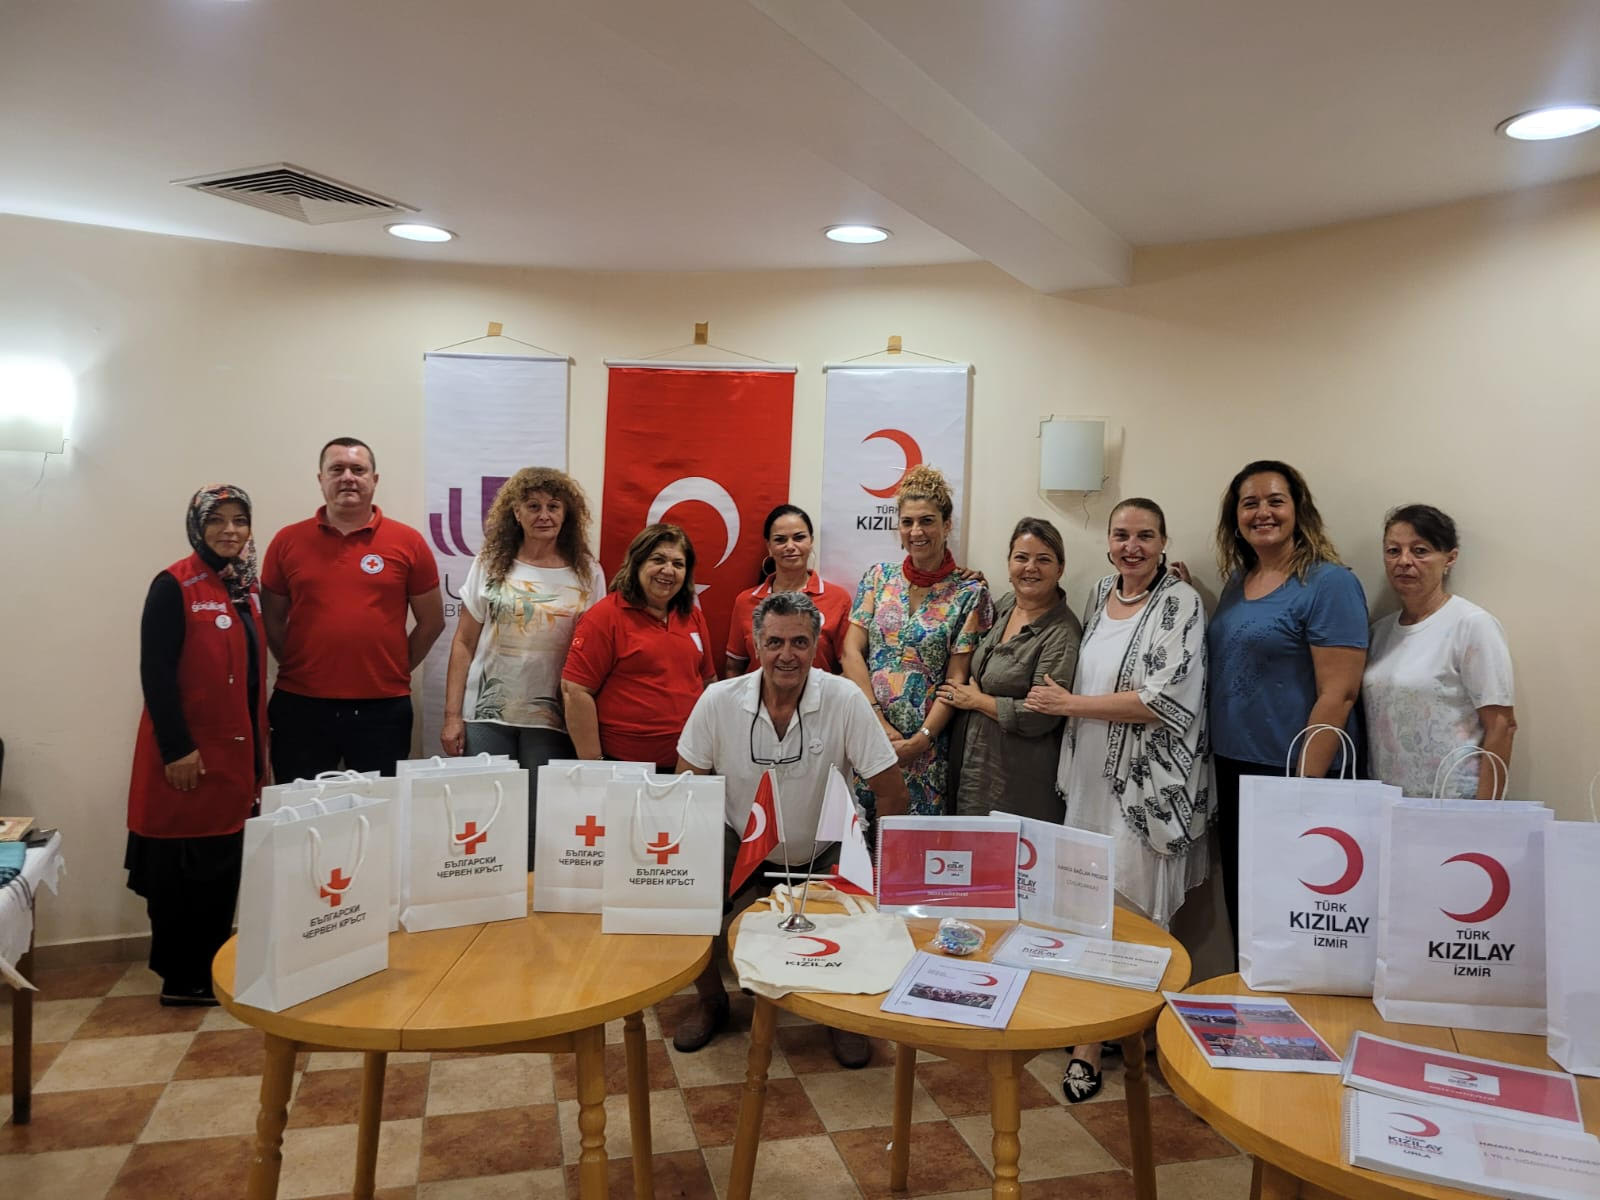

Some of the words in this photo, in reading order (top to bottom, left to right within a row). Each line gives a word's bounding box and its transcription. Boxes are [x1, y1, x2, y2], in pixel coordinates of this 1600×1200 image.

[444, 856, 497, 869] БЪЛГАРСКИ
[559, 858, 591, 866] ЧЕРВЕН
[437, 868, 472, 878] ЧЕРВЕН
[474, 864, 504, 875] КРЪСТ
[636, 868, 689, 876] БЪЛГАРСКИ
[629, 878, 664, 886] ЧЕРВЕН
[665, 878, 695, 886] КРЪСТ
[1314, 900, 1347, 912] TÜRK
[310, 904, 361, 927] БЪЛГАРСКИ
[302, 922, 337, 939] ЧЕРВЕН
[339, 912, 367, 928] КРЪСТ
[1290, 911, 1370, 934] KIZILAY
[1456, 928, 1490, 940] TÜRK
[1314, 935, 1348, 948] İZMİR
[1428, 941, 1515, 961] KIZILAY
[1454, 964, 1491, 977] İZMİR
[1388, 1135, 1443, 1151] KIZILAY
